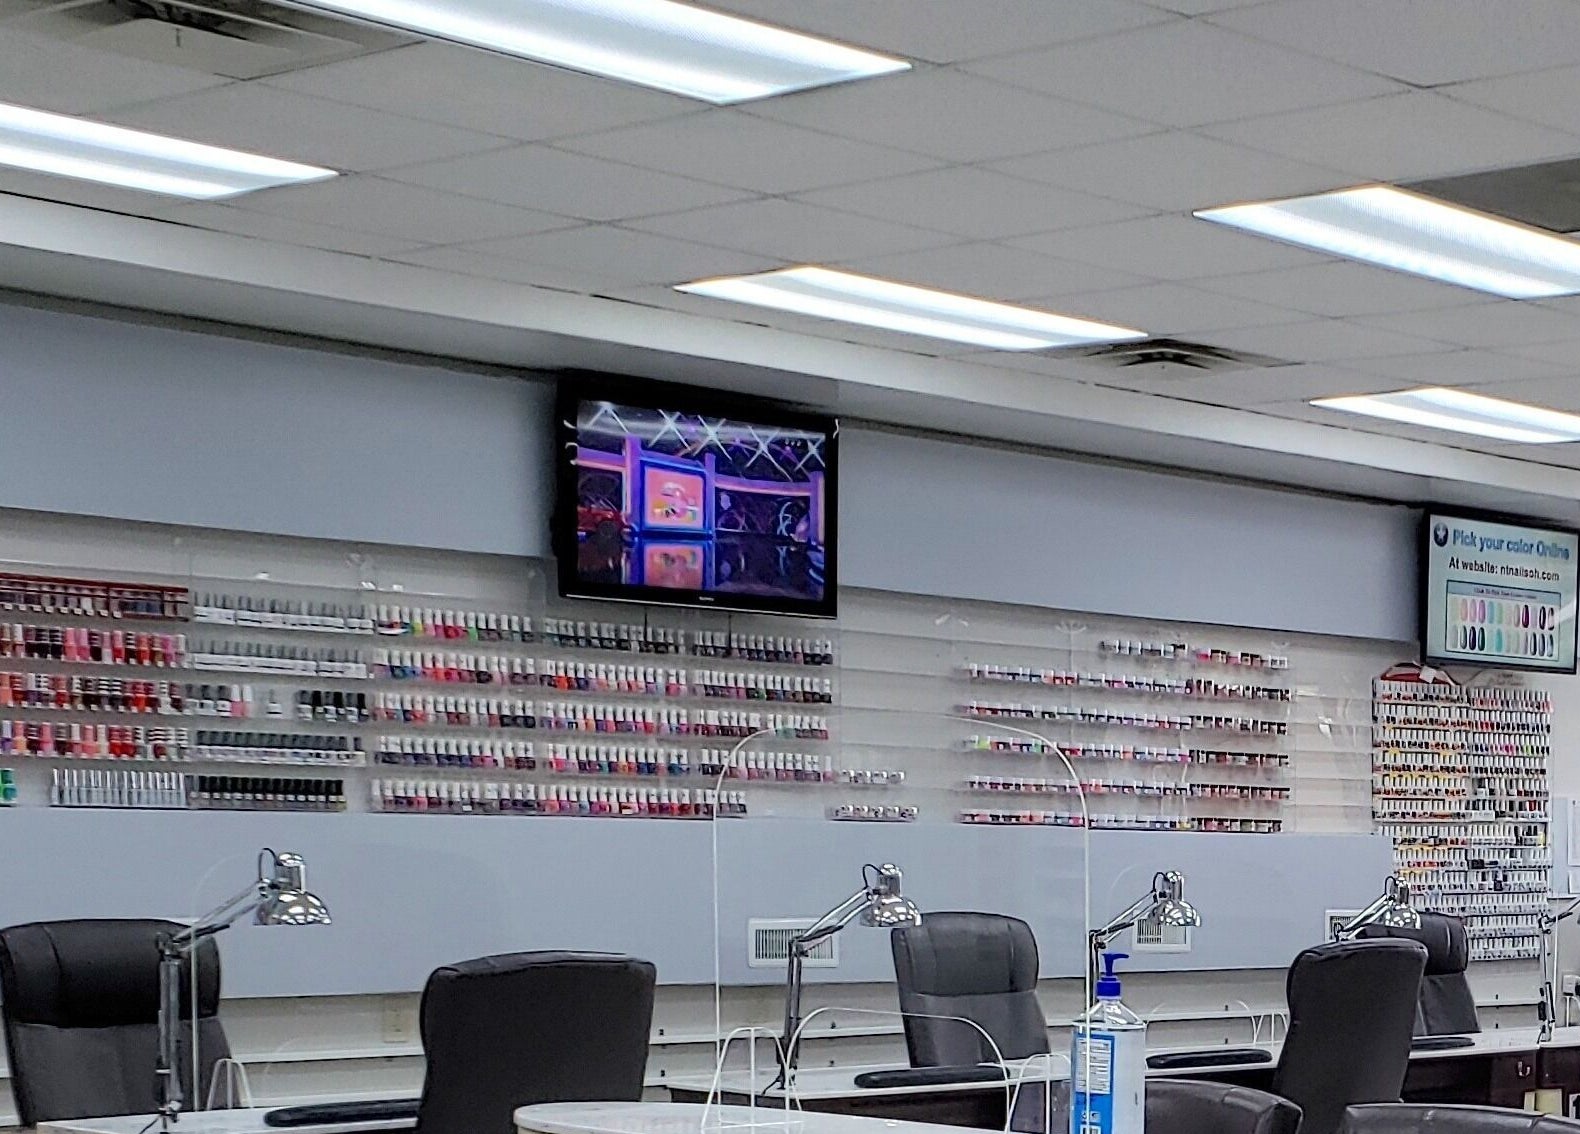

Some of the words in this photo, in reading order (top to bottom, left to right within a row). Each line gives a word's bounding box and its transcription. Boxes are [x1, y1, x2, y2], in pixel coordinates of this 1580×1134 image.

[1453, 529, 1477, 547] Pick
[1479, 536, 1504, 552] your
[1506, 538, 1534, 555] color
[1536, 540, 1570, 560] Online
[1448, 556, 1460, 570] At
[1461, 560, 1498, 575] website:
